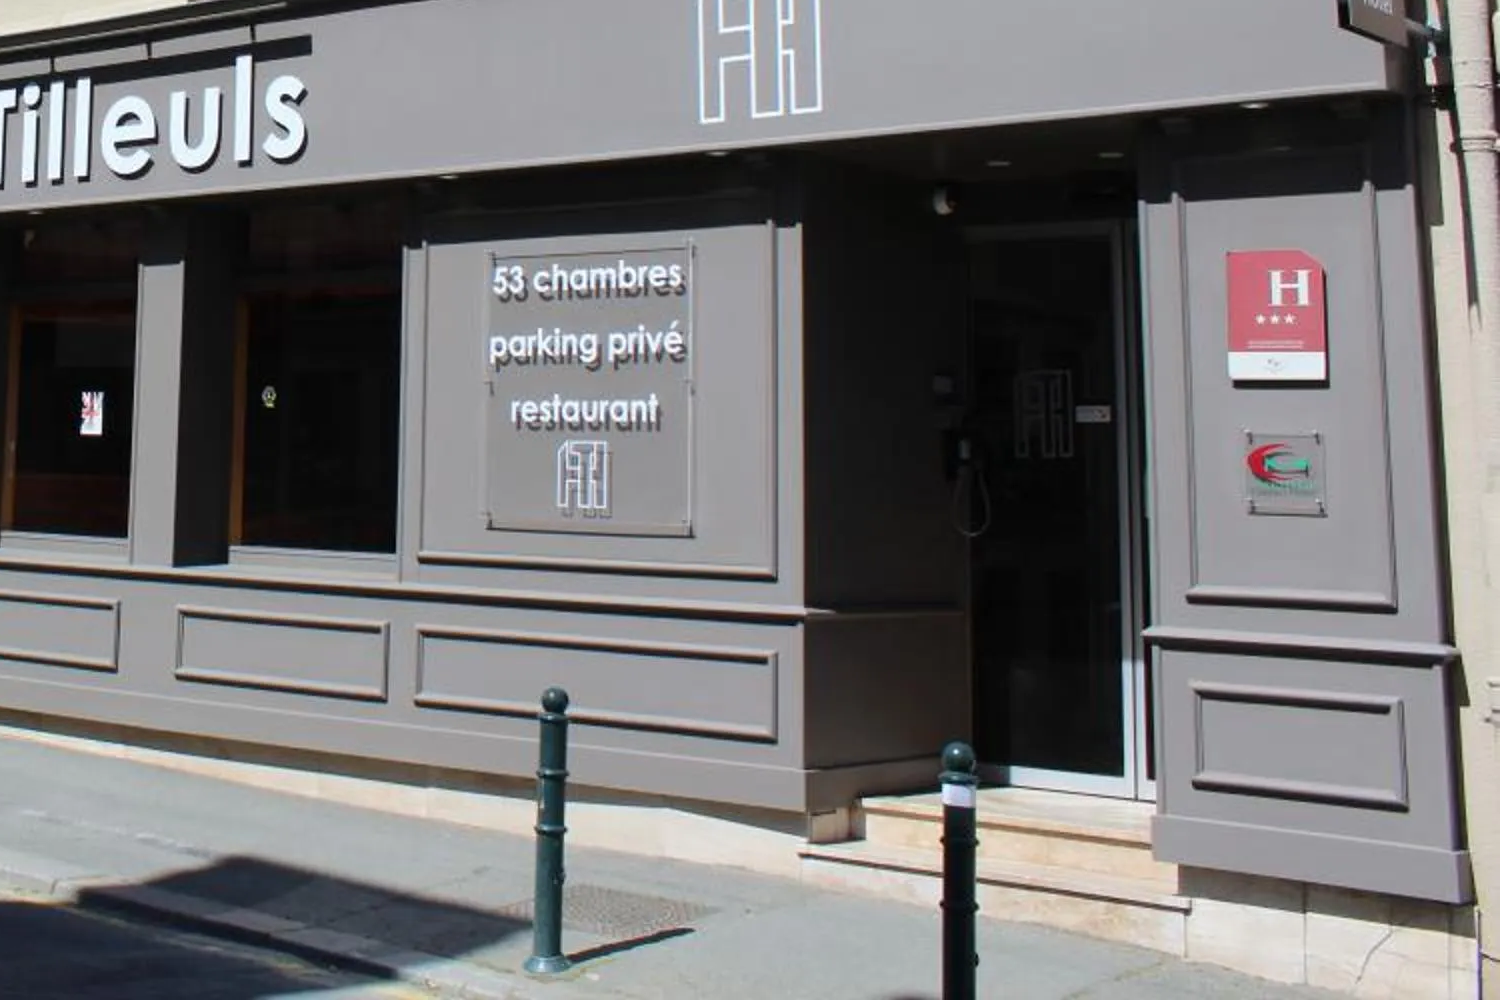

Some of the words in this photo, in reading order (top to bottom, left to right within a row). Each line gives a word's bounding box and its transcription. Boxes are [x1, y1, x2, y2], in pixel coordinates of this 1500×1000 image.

[492, 265, 524, 295] 53
[533, 259, 682, 292] chambres
[1267, 269, 1312, 307] H
[489, 327, 598, 364] parking
[608, 320, 684, 362] privé
[510, 393, 659, 423] restaurant
